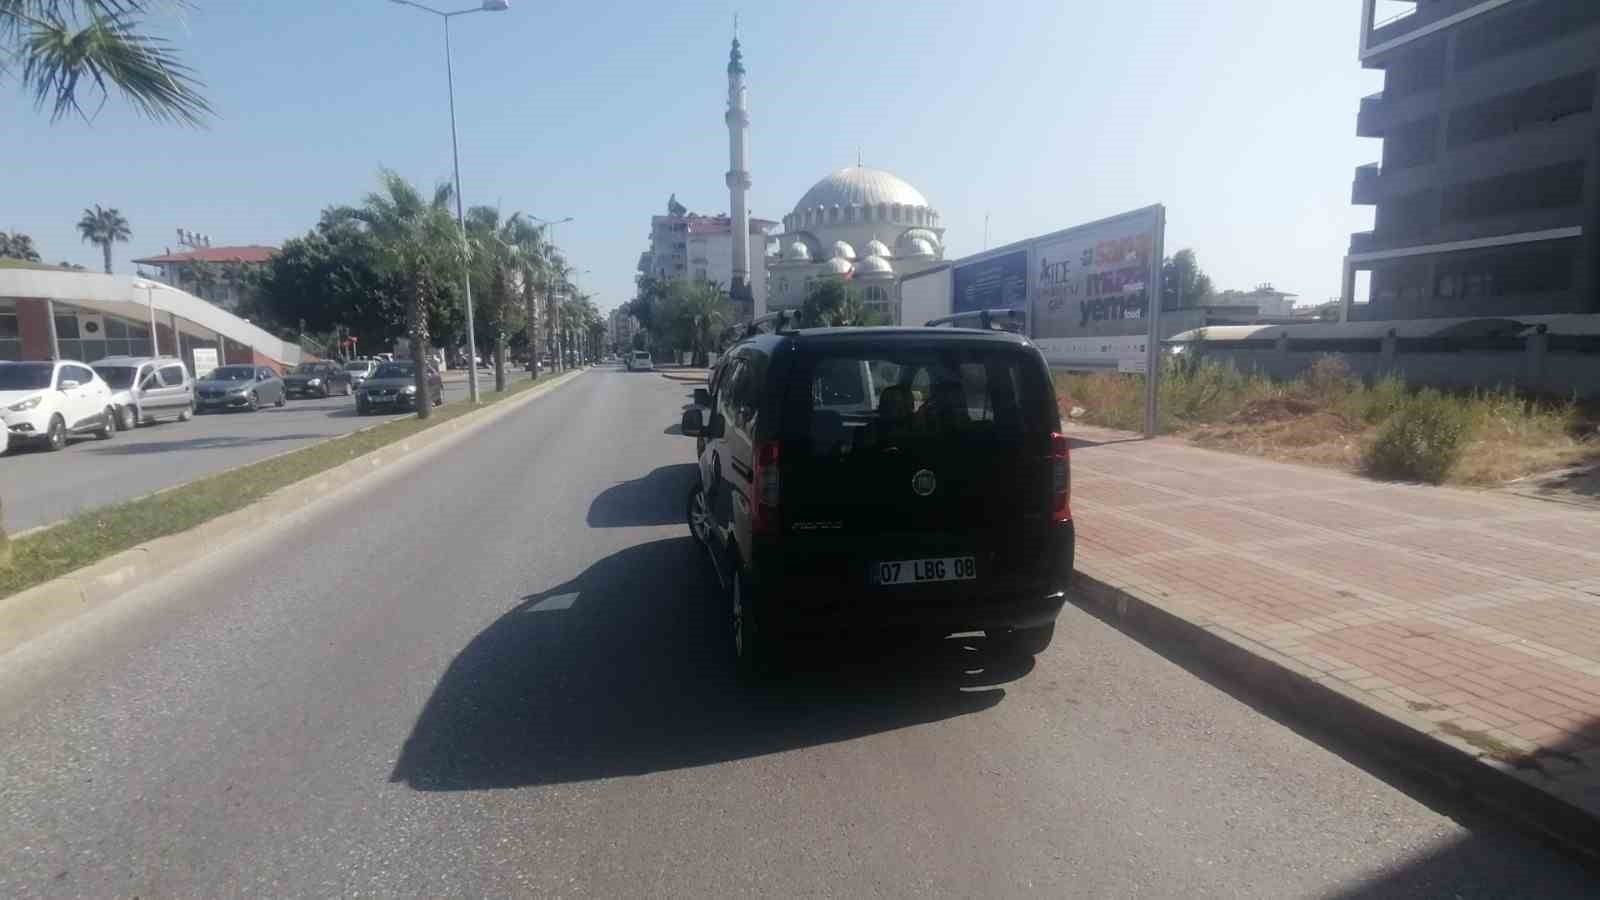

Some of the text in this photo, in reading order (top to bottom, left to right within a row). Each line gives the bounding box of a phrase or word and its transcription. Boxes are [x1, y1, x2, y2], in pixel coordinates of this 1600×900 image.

[881, 563, 900, 582] 07
[914, 560, 945, 581] LBG
[954, 558, 975, 578] 08
